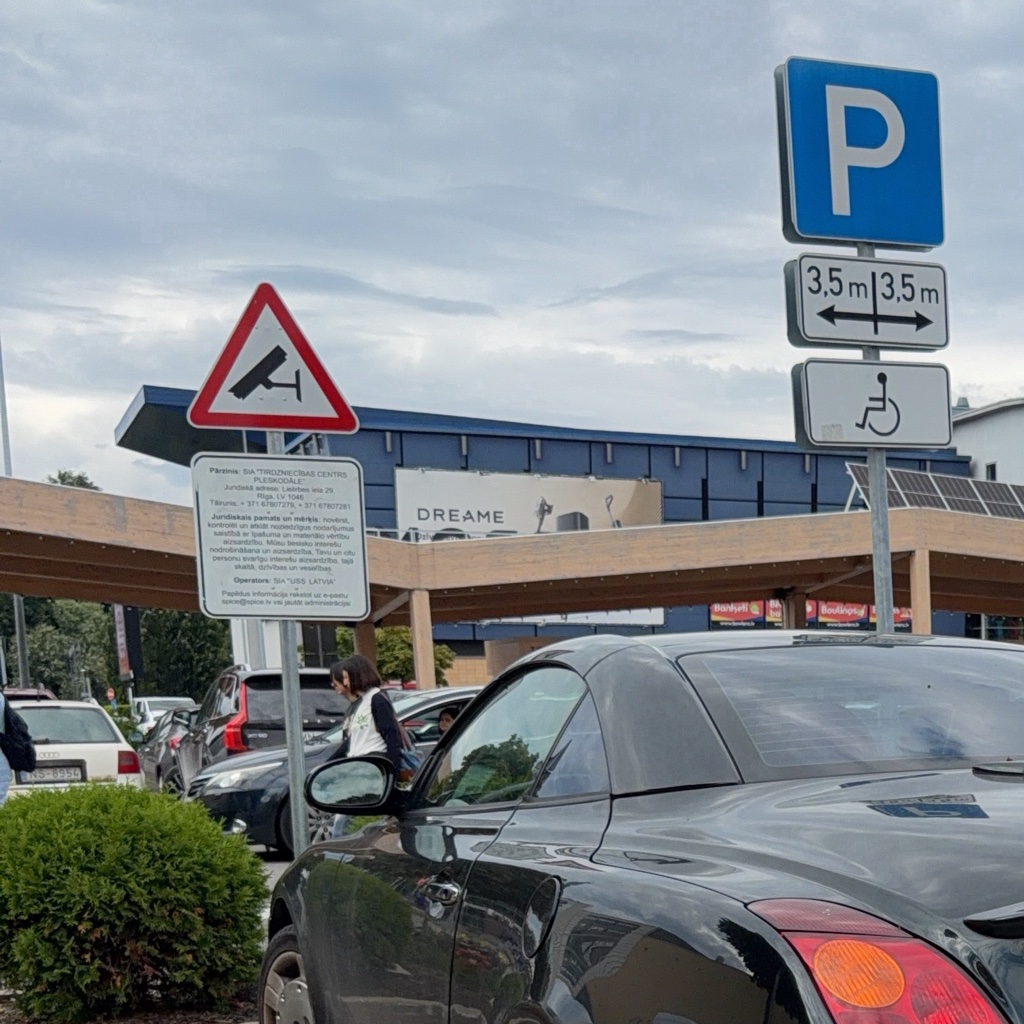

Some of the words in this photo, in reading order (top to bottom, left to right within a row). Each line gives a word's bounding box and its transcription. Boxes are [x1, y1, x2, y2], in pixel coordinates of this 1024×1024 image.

[826, 84, 905, 216] P
[807, 265, 843, 298] 3,5
[849, 281, 868, 298] m
[880, 272, 915, 303] 3,5
[921, 286, 939, 304] m
[209, 467, 241, 475] Pārzinis:
[417, 508, 504, 523] DREAME
